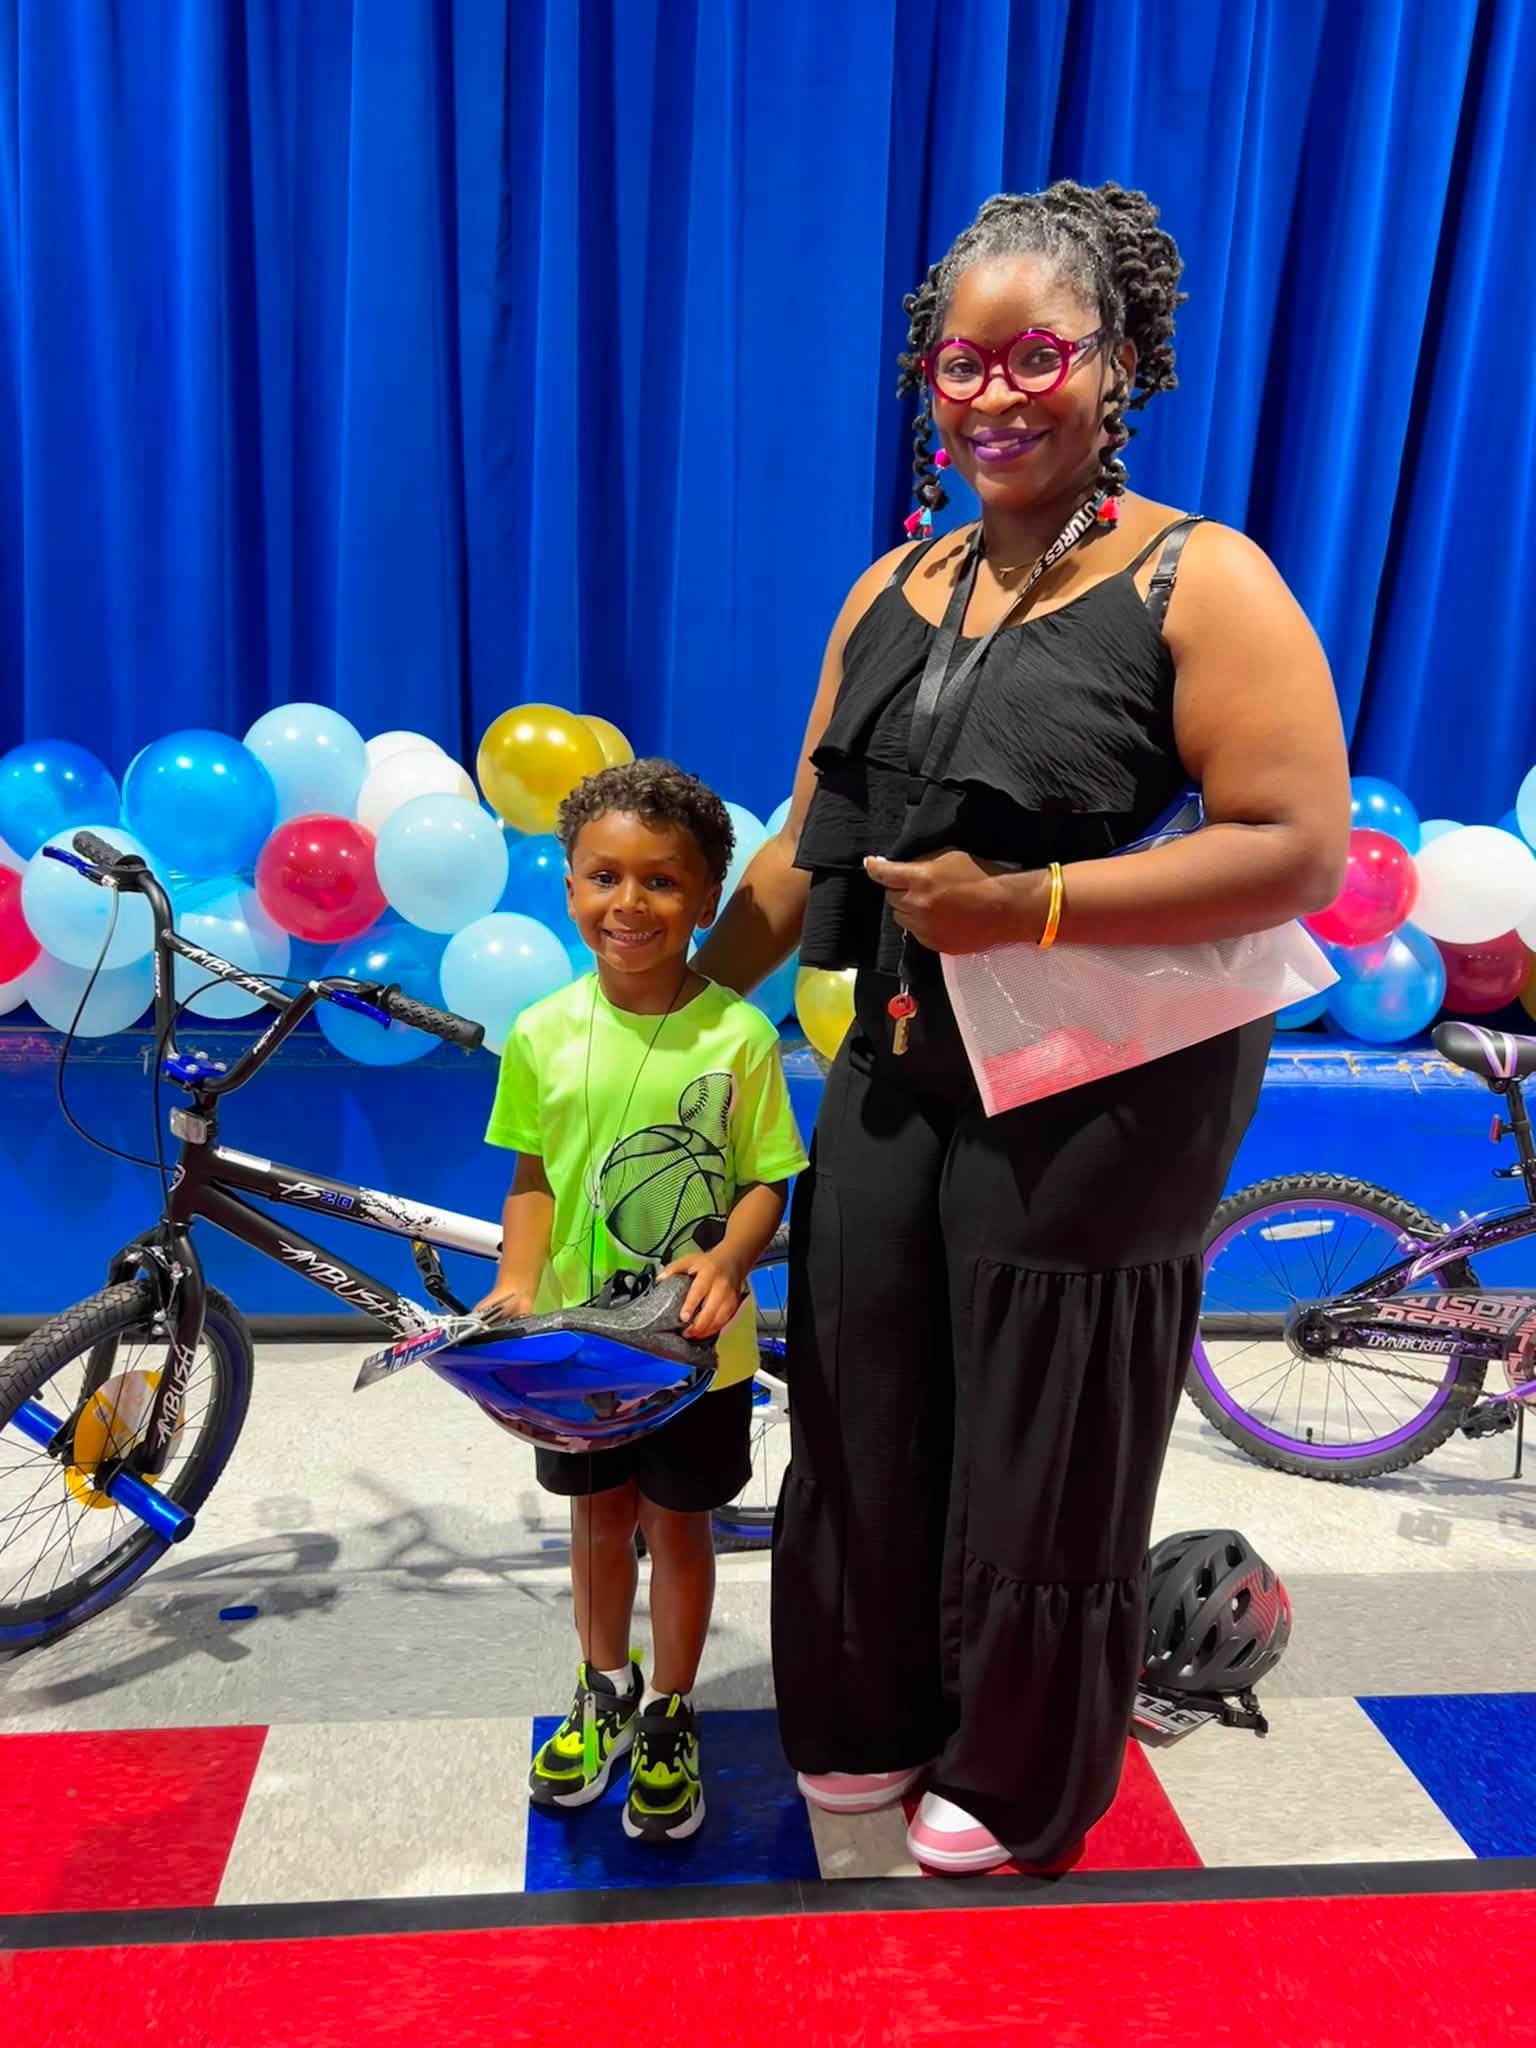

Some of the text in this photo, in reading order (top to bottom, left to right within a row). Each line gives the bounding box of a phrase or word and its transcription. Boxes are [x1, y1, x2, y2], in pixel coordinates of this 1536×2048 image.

[278, 1240, 400, 1319] AMBUSH
[1368, 1335, 1460, 1354] DYNACRAFT
[157, 1344, 195, 1448] AMBUSH
